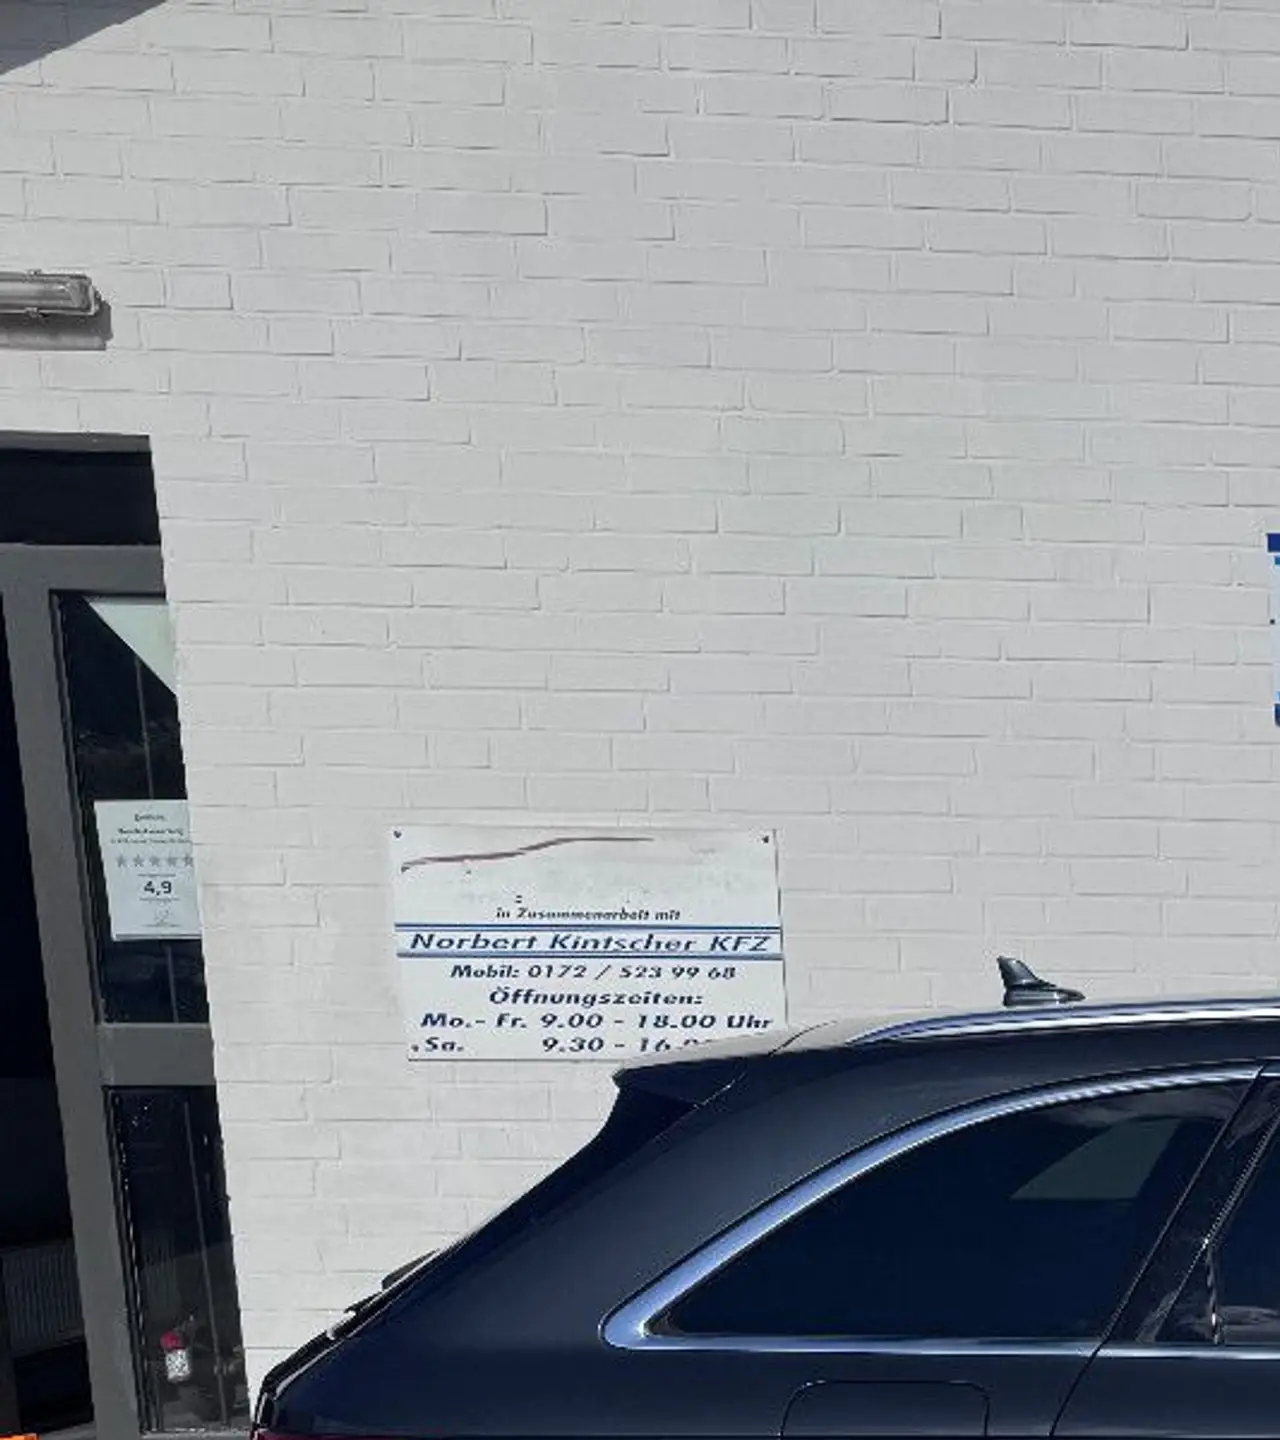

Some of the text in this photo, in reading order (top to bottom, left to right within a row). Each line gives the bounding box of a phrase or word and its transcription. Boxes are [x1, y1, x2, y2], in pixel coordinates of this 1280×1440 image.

[143, 880, 173, 896] 4,9
[495, 906, 681, 921] in Zusammenarbeit mit
[410, 933, 773, 952] Norbert Kintscher KFZ
[450, 963, 737, 981] Mobil: 0172 / 523 99 68
[488, 986, 704, 1009] Öffnungszeiten:
[495, 1012, 528, 1029] Fr.
[539, 1012, 605, 1029] 9.00
[637, 1013, 717, 1029] 18.00
[726, 1014, 774, 1029] Uhr
[424, 1036, 465, 1053] Sa.
[541, 1036, 605, 1053] 9.30
